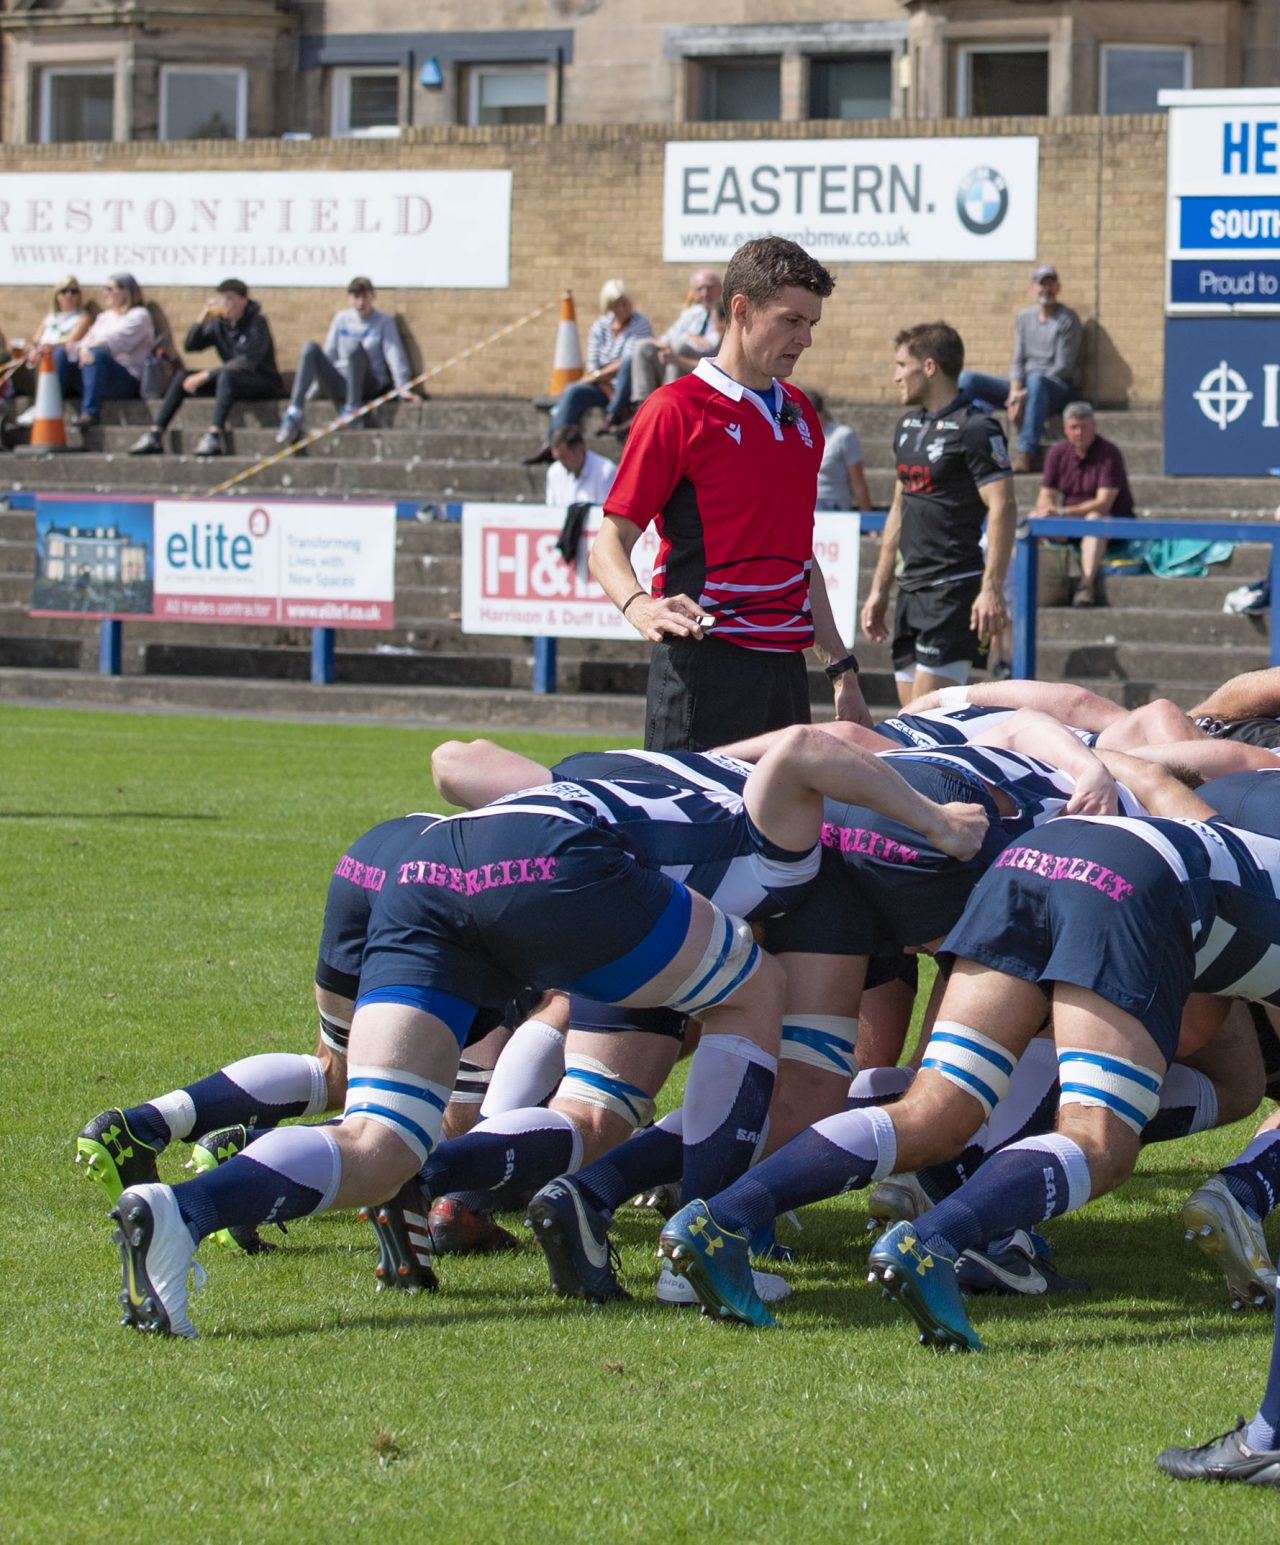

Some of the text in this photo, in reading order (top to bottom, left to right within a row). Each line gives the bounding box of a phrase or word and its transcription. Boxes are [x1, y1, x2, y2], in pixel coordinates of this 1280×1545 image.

[683, 164, 936, 216] EASTERN.
[0, 194, 433, 236] RESTONFIELD
[11, 245, 348, 268] WWW.PRESTONFIELD.COM
[1200, 270, 1255, 294] Proud
[1258, 272, 1278, 295] to
[166, 523, 253, 570] elite
[480, 606, 542, 624] Harrison
[547, 607, 557, 625] &
[398, 855, 561, 897] TIGERLILY
[993, 847, 1134, 903] TIGERLILY
